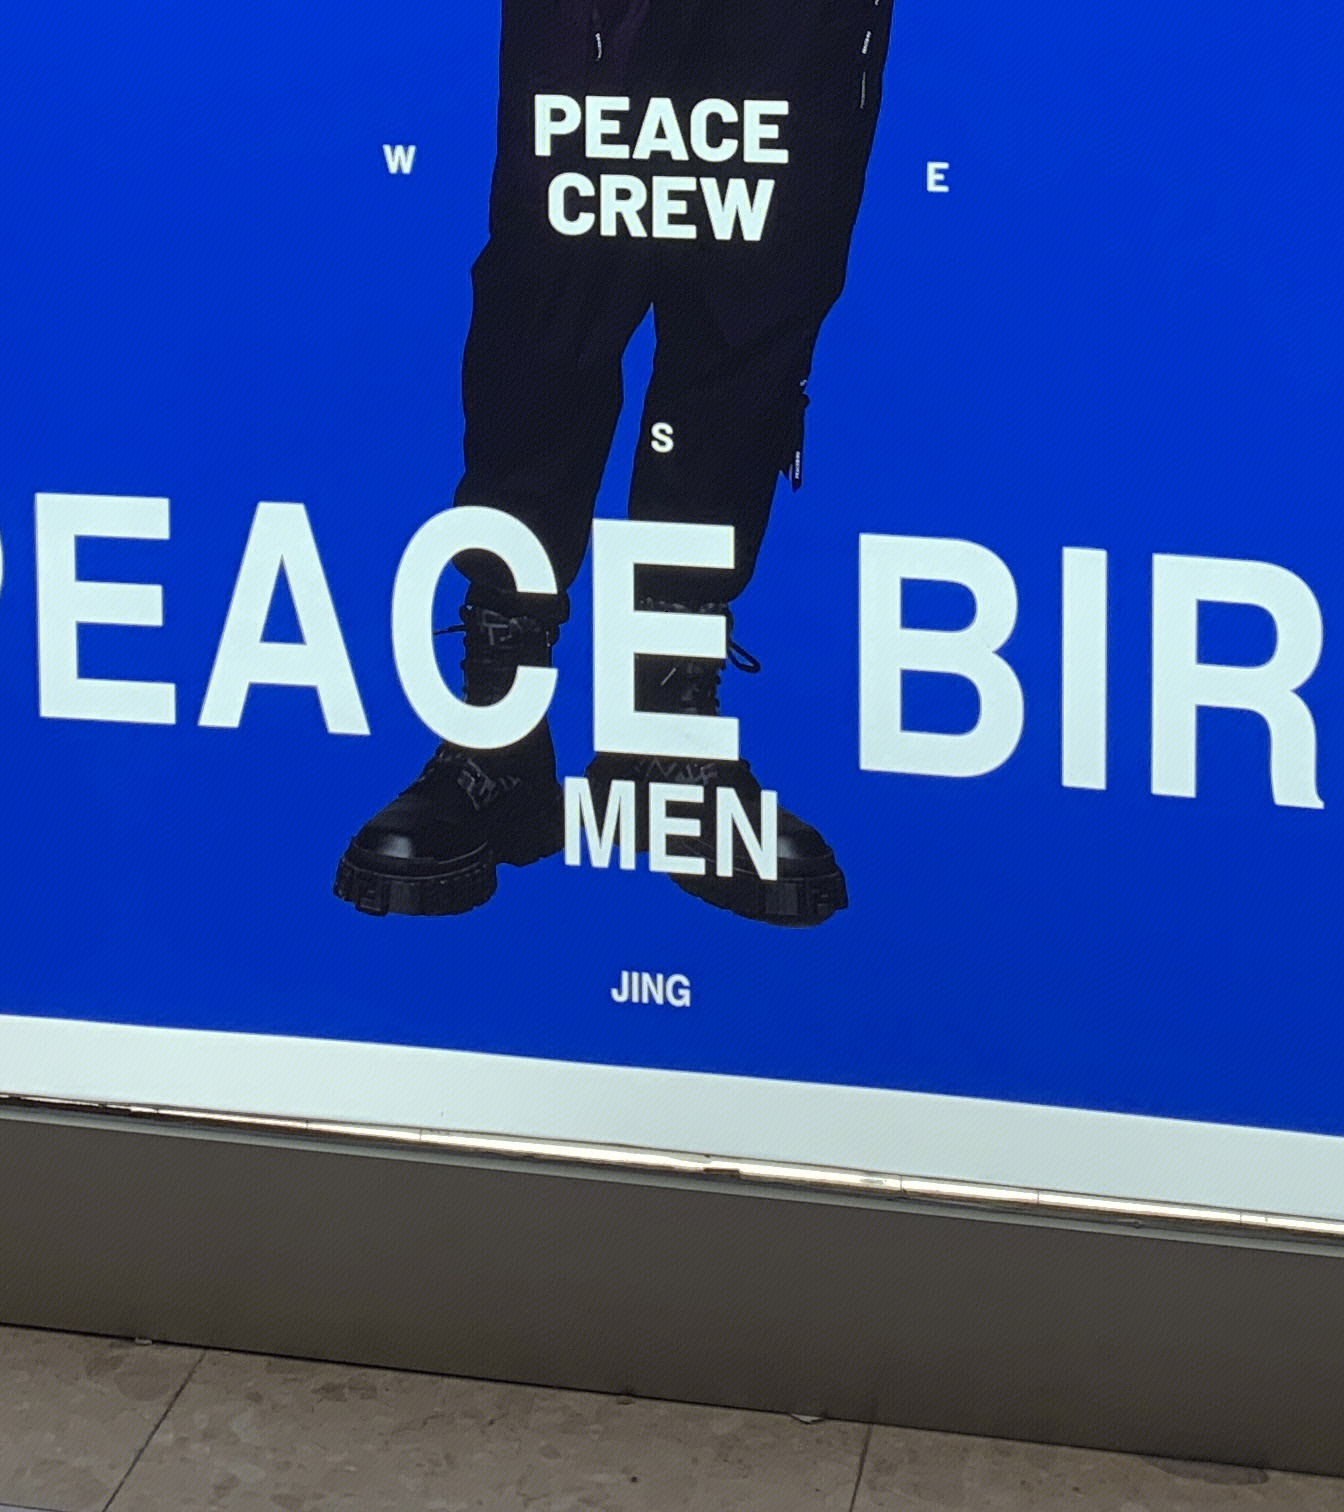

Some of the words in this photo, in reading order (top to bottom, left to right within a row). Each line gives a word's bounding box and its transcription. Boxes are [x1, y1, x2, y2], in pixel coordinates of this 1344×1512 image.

[533, 93, 789, 164] PEACE
[383, 144, 416, 174] W
[926, 161, 949, 192] E
[547, 172, 776, 242] CREW
[651, 422, 674, 453] S
[564, 776, 778, 881] MEN
[611, 970, 691, 1007] JING
